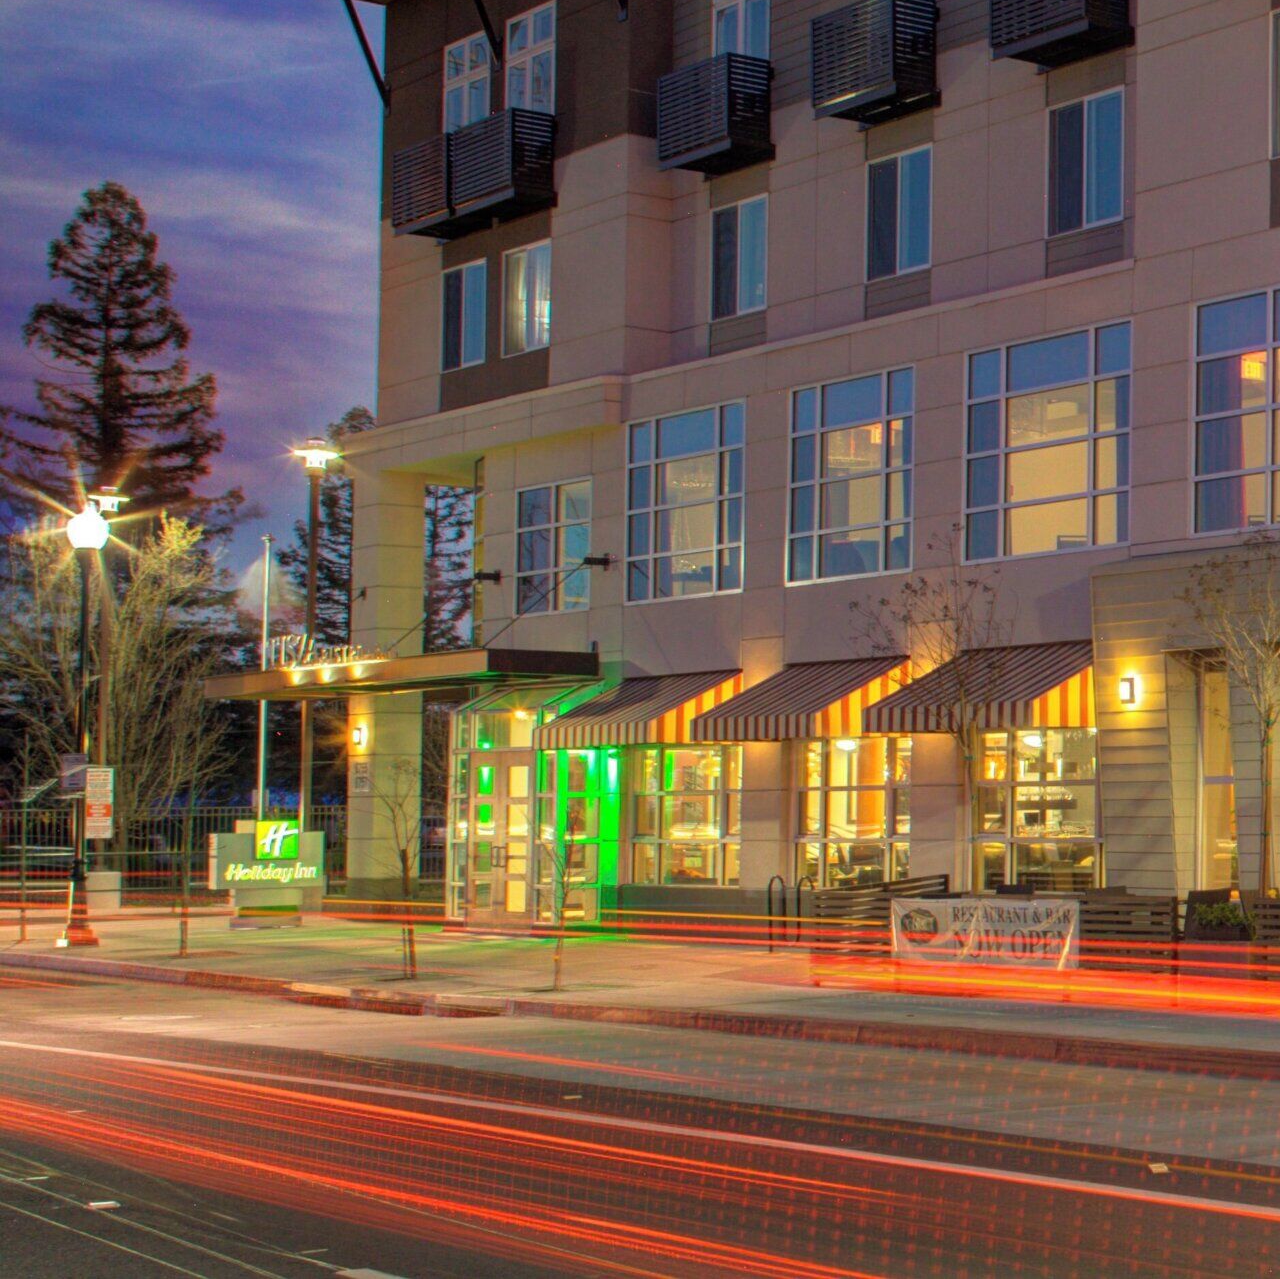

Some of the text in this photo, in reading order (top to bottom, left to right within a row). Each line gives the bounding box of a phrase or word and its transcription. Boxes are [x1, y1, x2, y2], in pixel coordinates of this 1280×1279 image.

[225, 862, 318, 883] Holiday Inn
[952, 905, 1071, 924] RESTAURANT & BAR
[953, 928, 1068, 960] NOW OPEN
